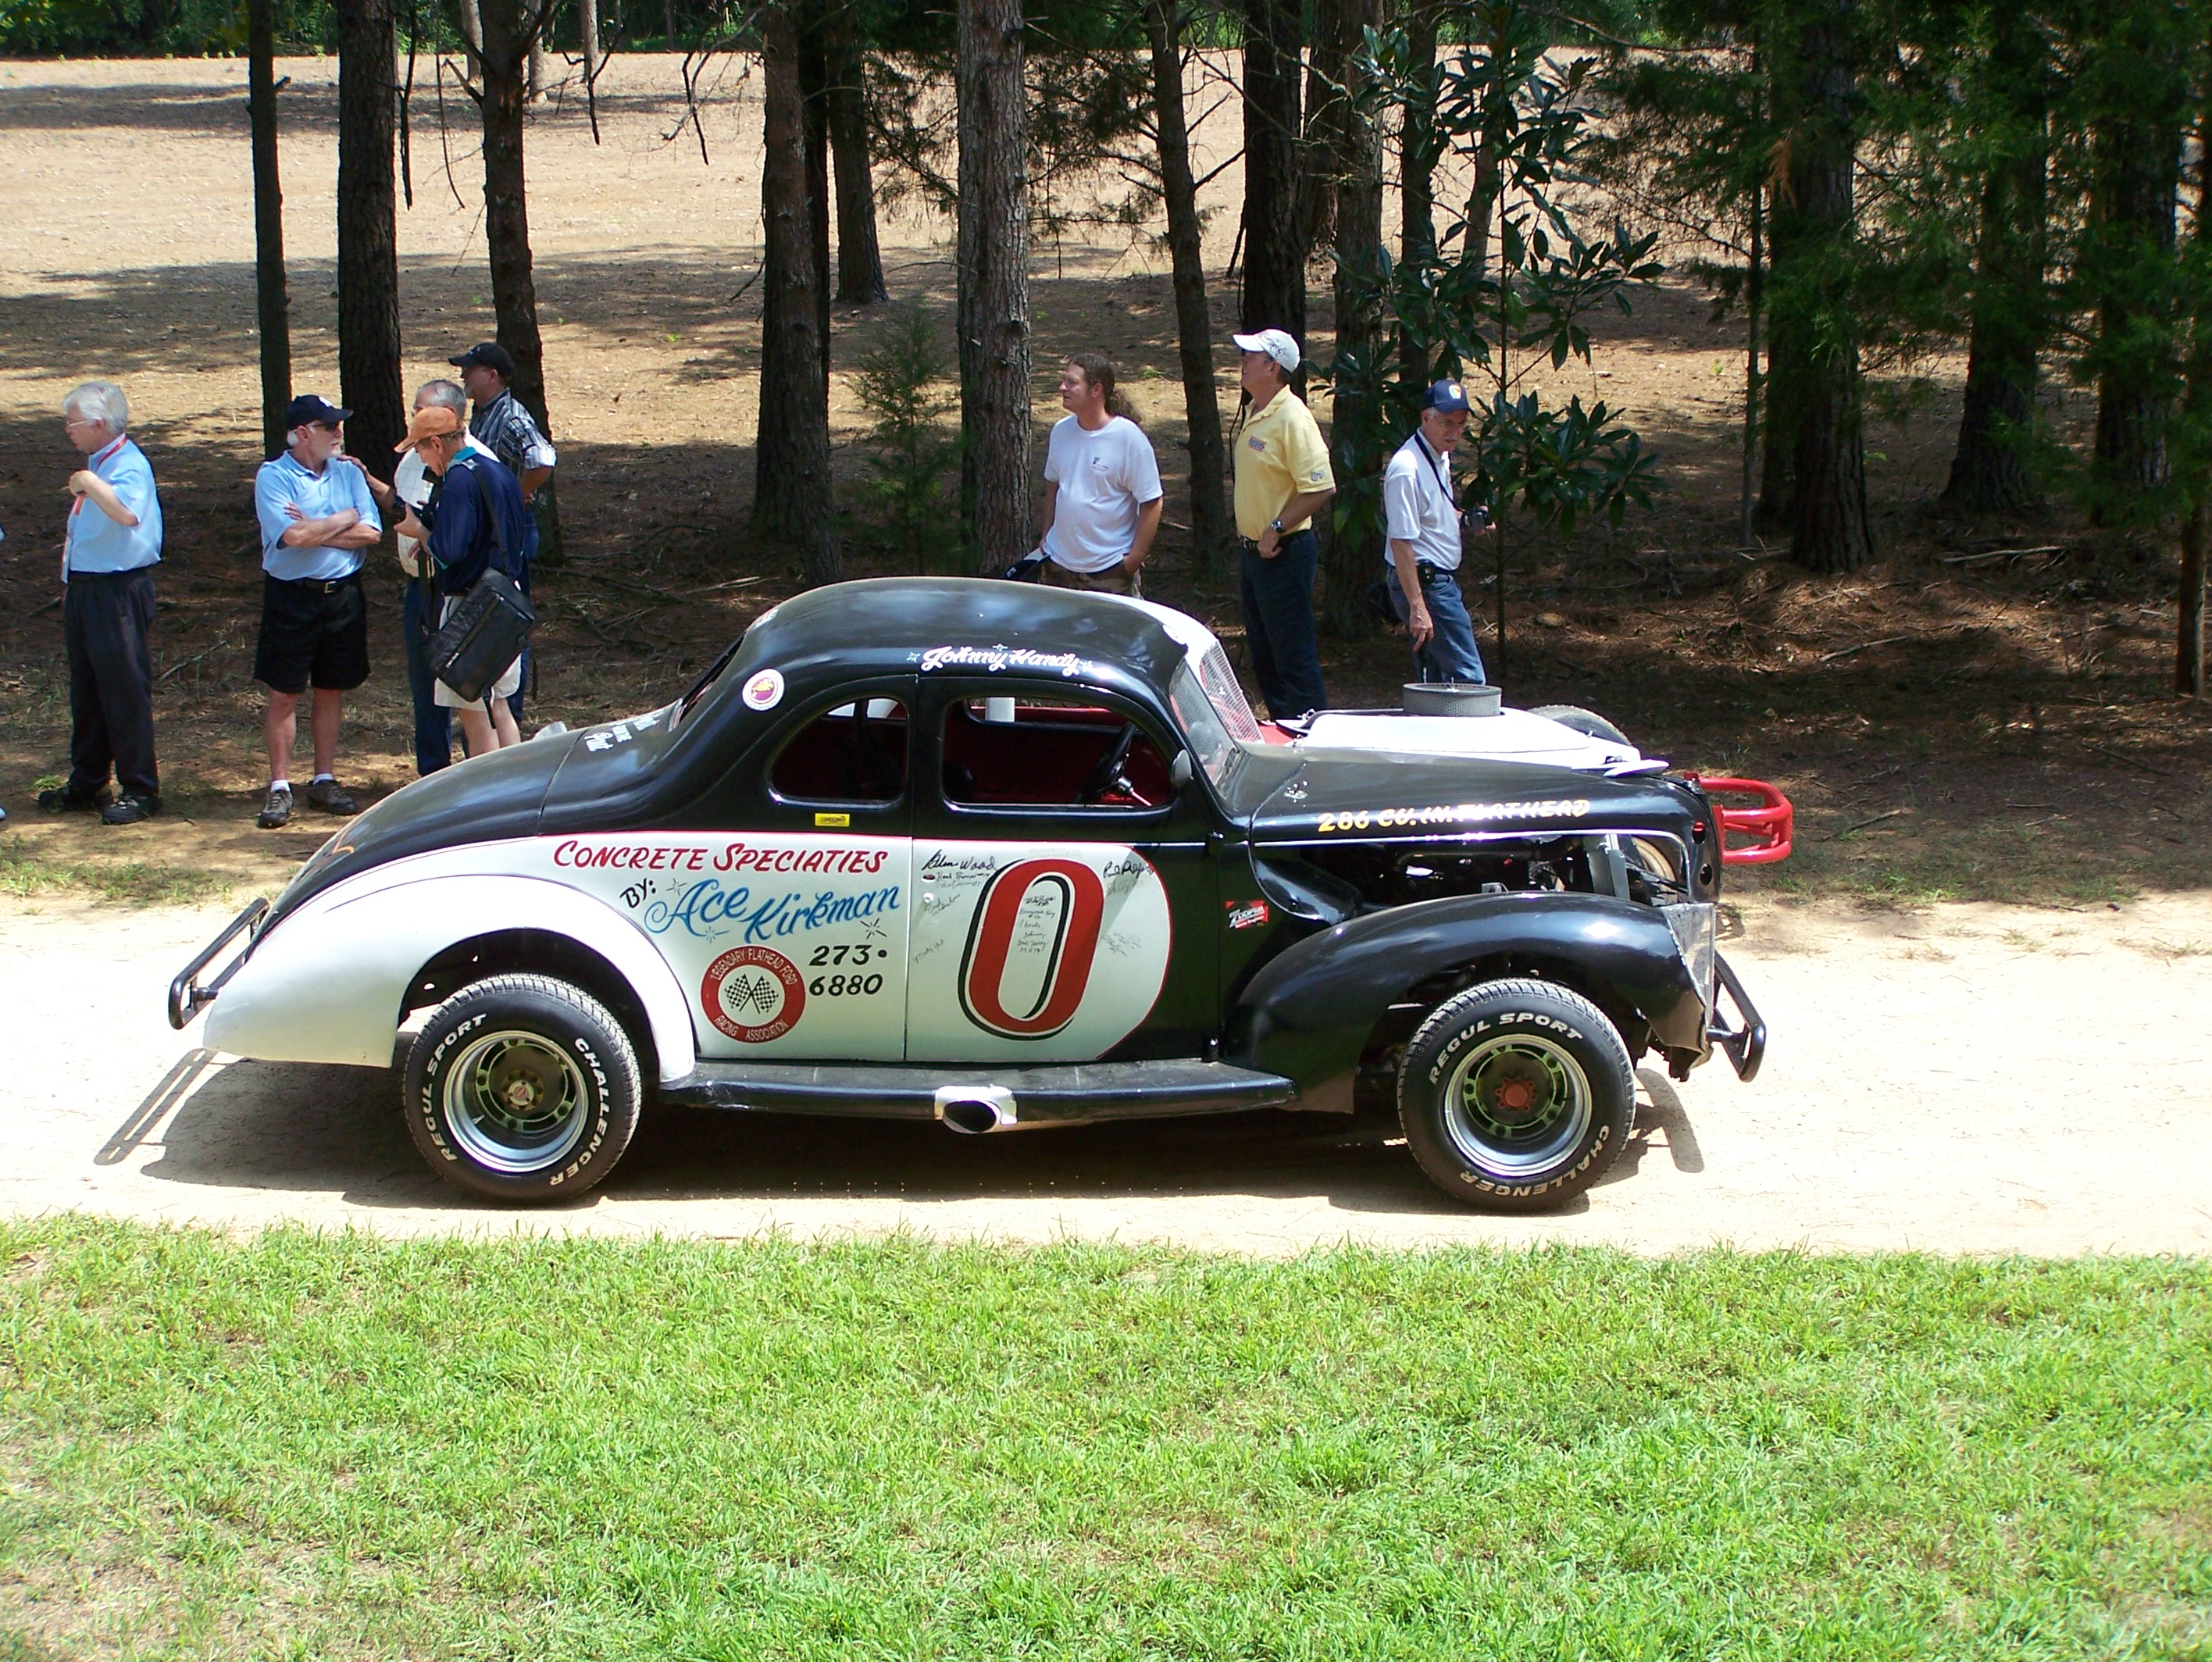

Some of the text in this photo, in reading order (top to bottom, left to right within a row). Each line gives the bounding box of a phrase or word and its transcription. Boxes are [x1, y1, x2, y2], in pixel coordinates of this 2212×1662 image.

[920, 646, 1080, 676] Johnny Handy
[1318, 810, 1370, 833] 286
[1457, 798, 1591, 822] FLATHEAD
[554, 840, 889, 874] CONCRETE SPECIATIES
[644, 879, 901, 944] Ace Kirkman
[709, 948, 797, 985] LEGENDARY FLATHEAD FORD
[958, 857, 1105, 1041] 0
[809, 973, 883, 997] 6880
[714, 1015, 789, 1041] RACING ASSOCIATION
[1429, 1012, 1583, 1085] REGUL SPORT
[422, 1013, 487, 1161] REGUL SPORT
[549, 1037, 611, 1186] CHALLENGER
[1459, 1125, 1611, 1197] CHALLENGER
